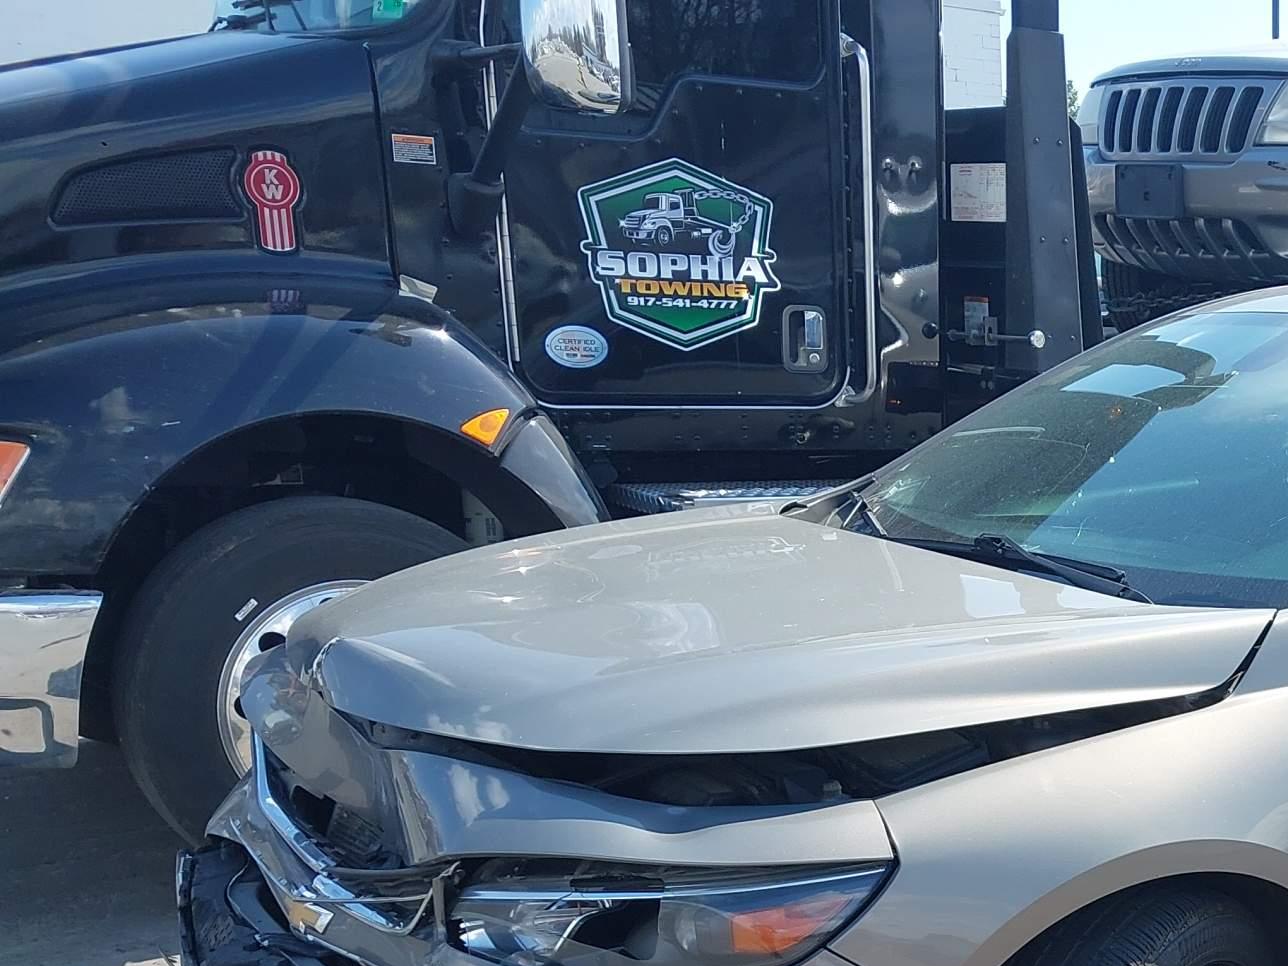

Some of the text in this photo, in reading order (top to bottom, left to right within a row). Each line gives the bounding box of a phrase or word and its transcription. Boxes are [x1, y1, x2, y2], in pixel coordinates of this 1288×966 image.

[264, 168, 280, 185] K
[261, 184, 284, 200] W
[597, 250, 769, 283] SOPHIA
[616, 279, 749, 298] TOWING
[627, 296, 738, 309] 917-541-4777
